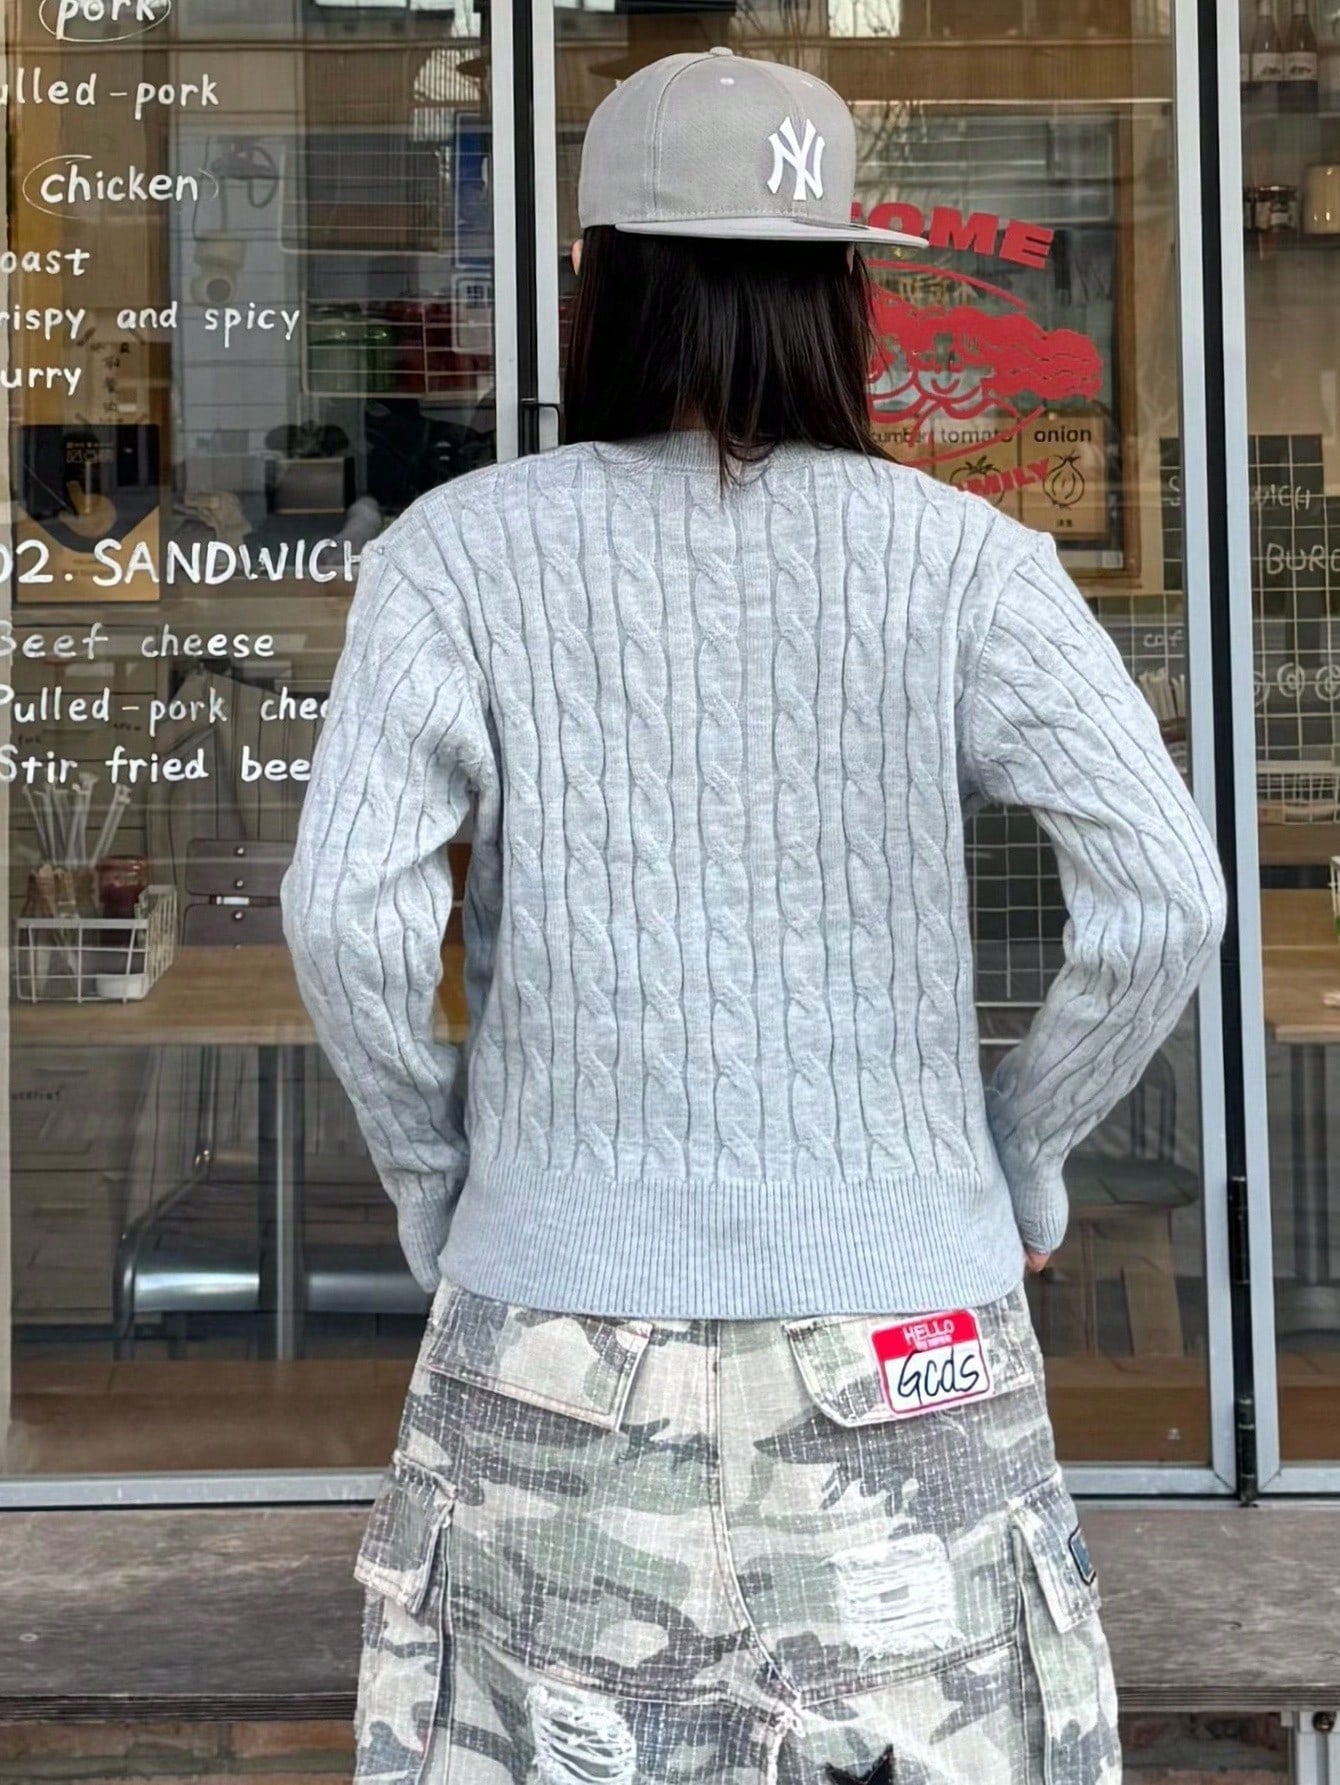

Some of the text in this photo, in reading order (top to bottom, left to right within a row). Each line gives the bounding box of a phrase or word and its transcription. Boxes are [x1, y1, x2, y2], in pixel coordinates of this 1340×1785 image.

[57, 0, 156, 40] pork
[767, 116, 825, 200] NY
[40, 164, 198, 204] chicken
[851, 202, 1054, 269] OME
[117, 301, 178, 329] and
[204, 302, 300, 348] spicy
[1034, 426, 1092, 443] onion
[141, 624, 274, 658] cheese
[0, 744, 78, 784] Stir
[105, 746, 209, 784] fried
[902, 1319, 955, 1347] HELLO
